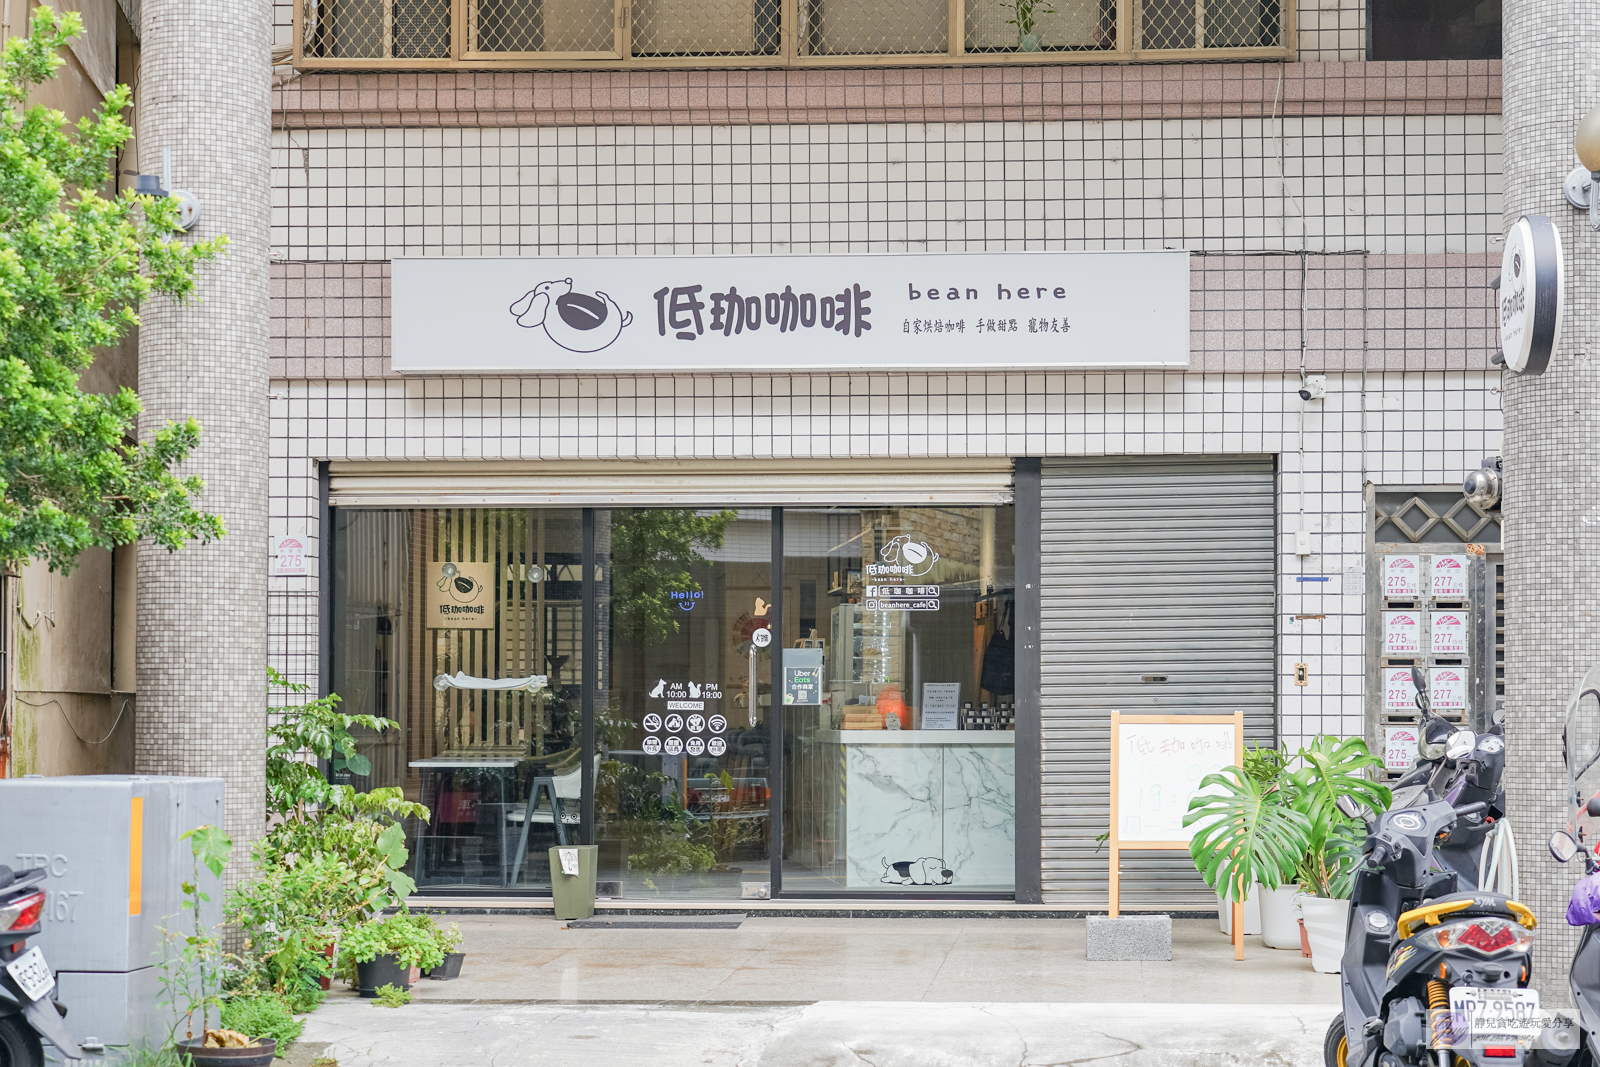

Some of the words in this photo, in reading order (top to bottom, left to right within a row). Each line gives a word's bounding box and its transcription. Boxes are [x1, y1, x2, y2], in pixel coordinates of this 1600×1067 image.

[908, 282, 978, 300] bean
[997, 283, 1067, 300] here
[653, 283, 872, 341] 低珈咖啡
[902, 318, 966, 335] 自家烘焙咖啡
[975, 318, 1018, 334] 手做甜點
[1027, 317, 1071, 334] 寵物友善
[280, 554, 302, 567] 275
[865, 564, 914, 575] 低珈咖啡
[1387, 576, 1406, 587] 275
[1434, 576, 1453, 587] 277
[670, 591, 704, 599] Hello!
[881, 587, 925, 595] 低珈咖啡
[439, 604, 485, 615] 低珈咖啡
[880, 601, 926, 609] beanhere_cafe
[1388, 633, 1407, 644] 275
[1434, 633, 1453, 644] 277
[705, 683, 718, 691] PM
[702, 691, 722, 699] 19:00
[1388, 690, 1407, 699] 275
[1433, 690, 1452, 699] 277
[1126, 731, 1234, 757] 低珈咖啡
[1388, 749, 1407, 759] 275
[16, 853, 69, 878] TPC
[1473, 896, 1496, 908] SYM
